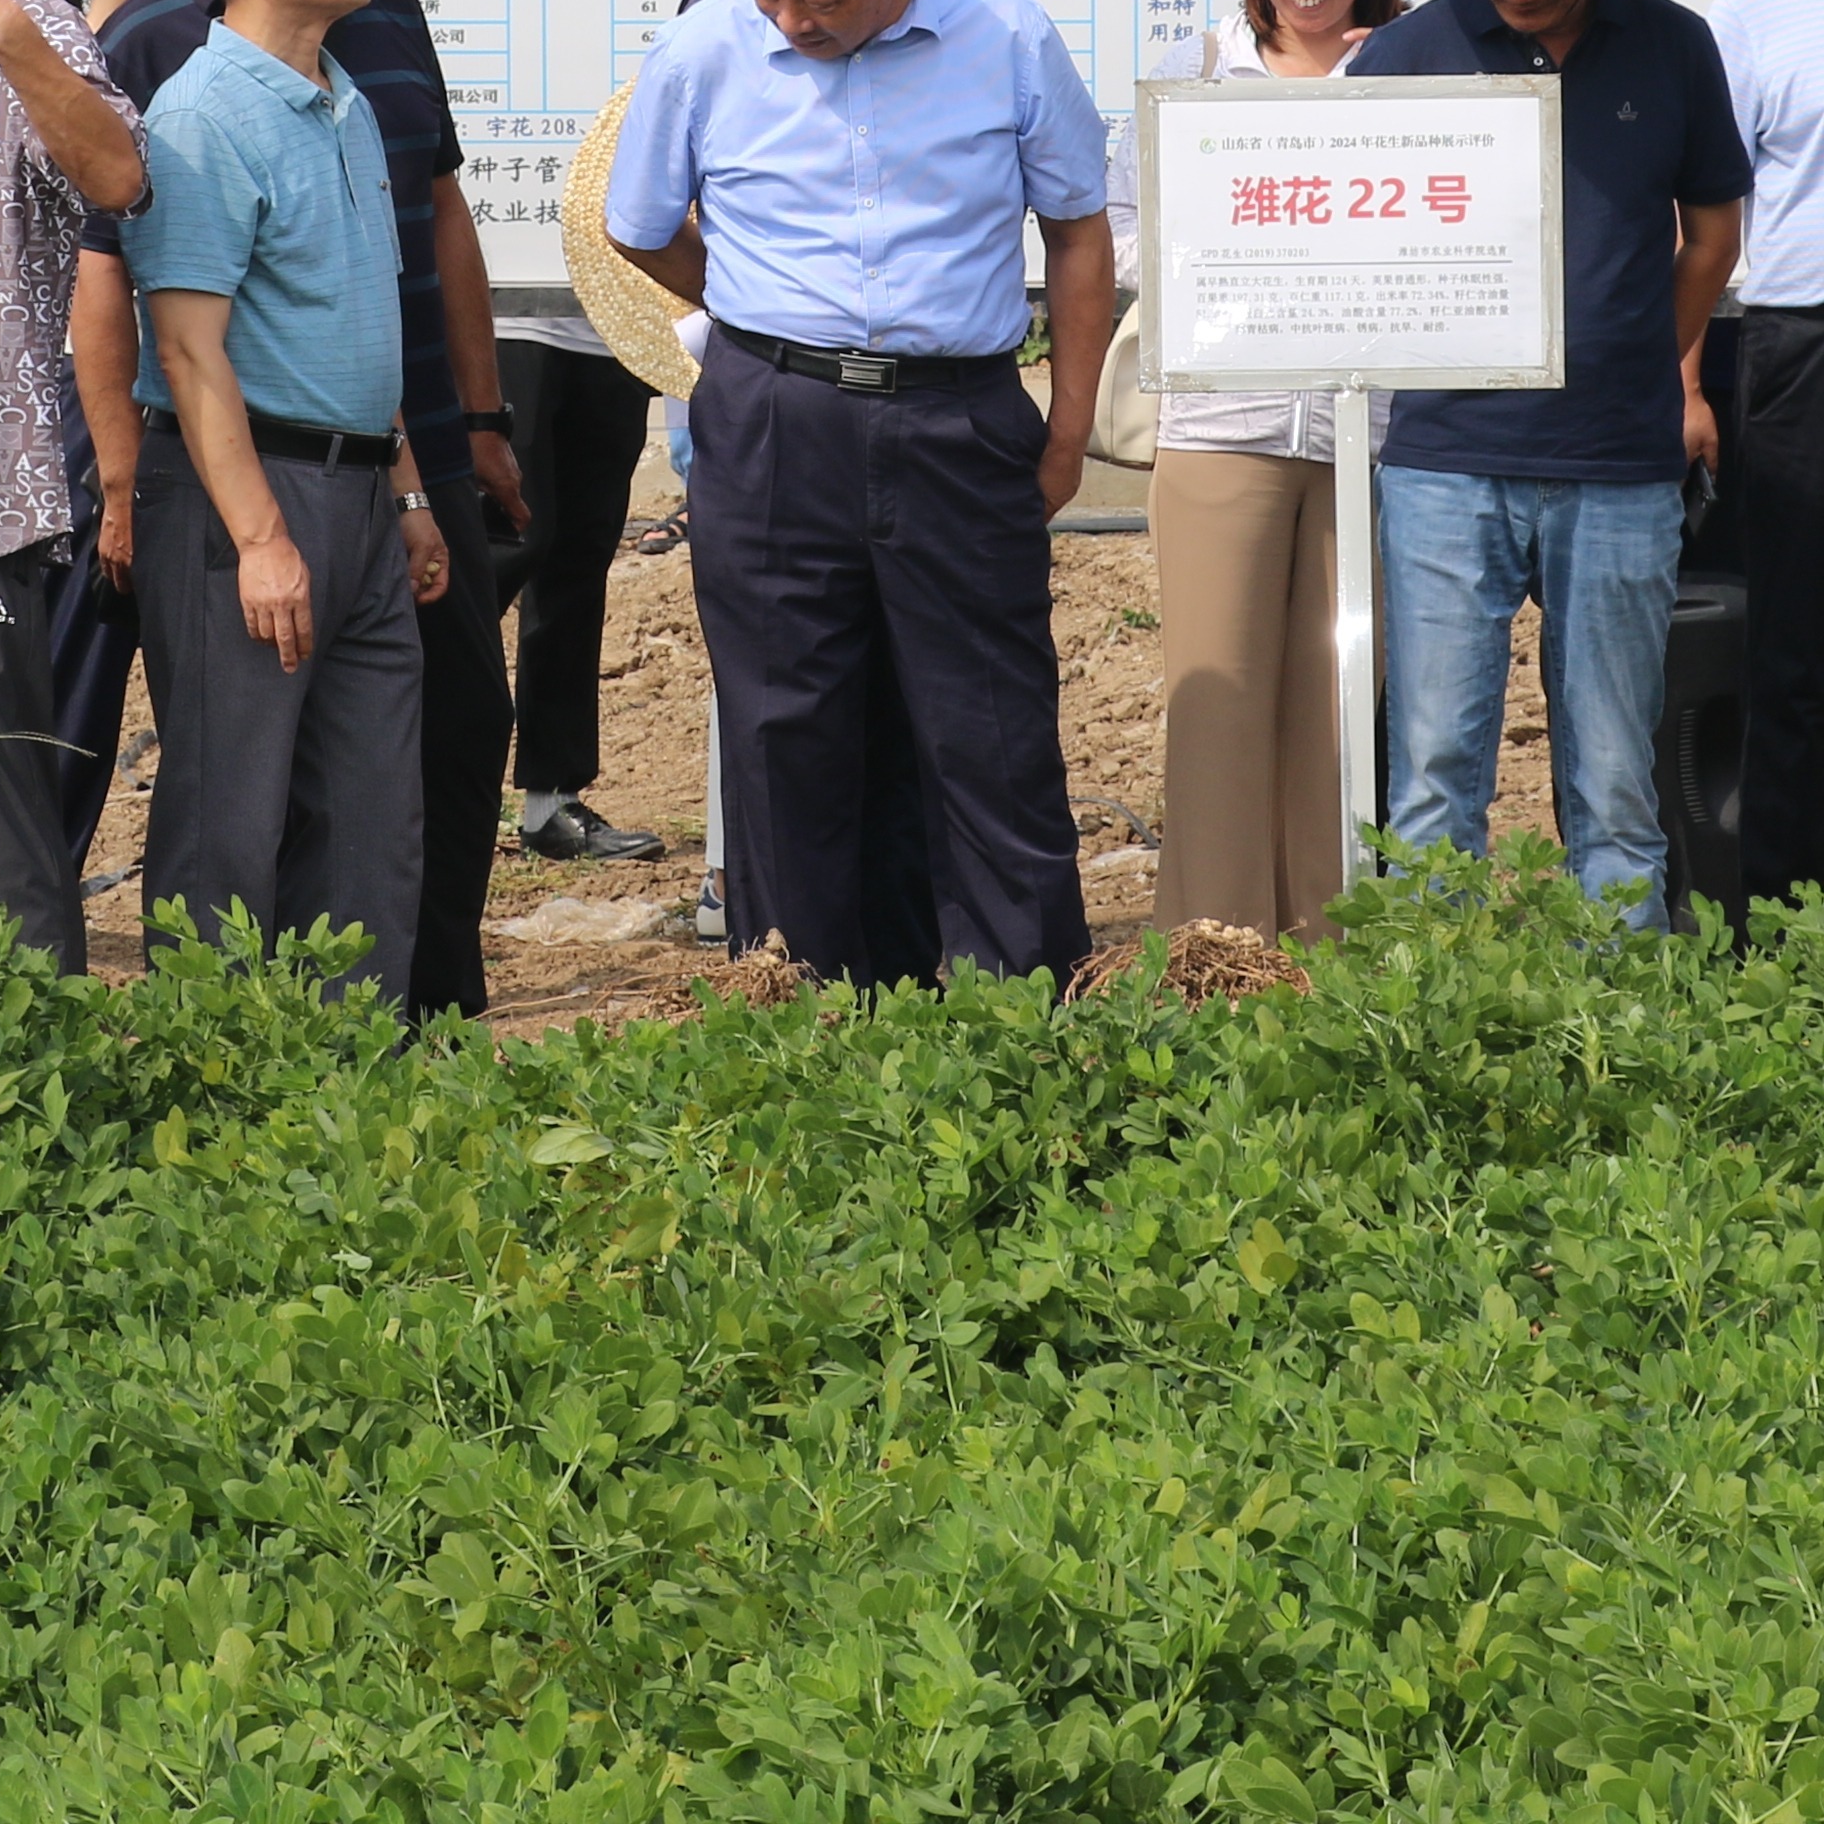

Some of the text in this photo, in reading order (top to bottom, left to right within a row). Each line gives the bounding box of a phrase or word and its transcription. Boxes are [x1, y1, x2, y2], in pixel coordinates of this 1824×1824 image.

[487, 116, 533, 138] 宇花
[1231, 176, 1472, 226] 潍花 22 号
